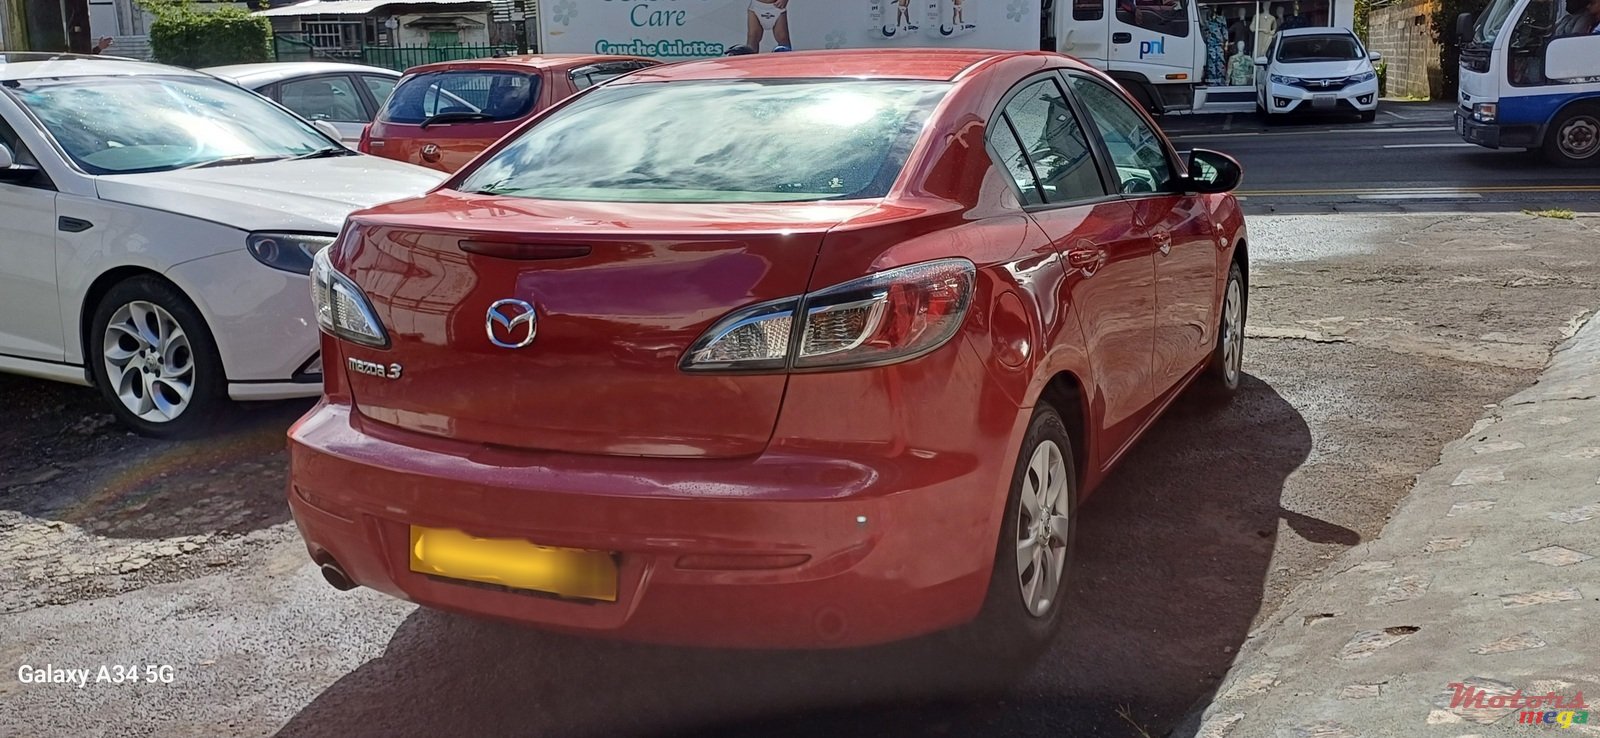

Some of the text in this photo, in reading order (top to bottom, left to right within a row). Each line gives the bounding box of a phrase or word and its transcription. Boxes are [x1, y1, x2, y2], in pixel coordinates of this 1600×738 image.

[630, 4, 686, 27] Care
[596, 39, 723, 57] Couche Culottes
[1140, 36, 1165, 59] pnl
[386, 362, 402, 379] 3
